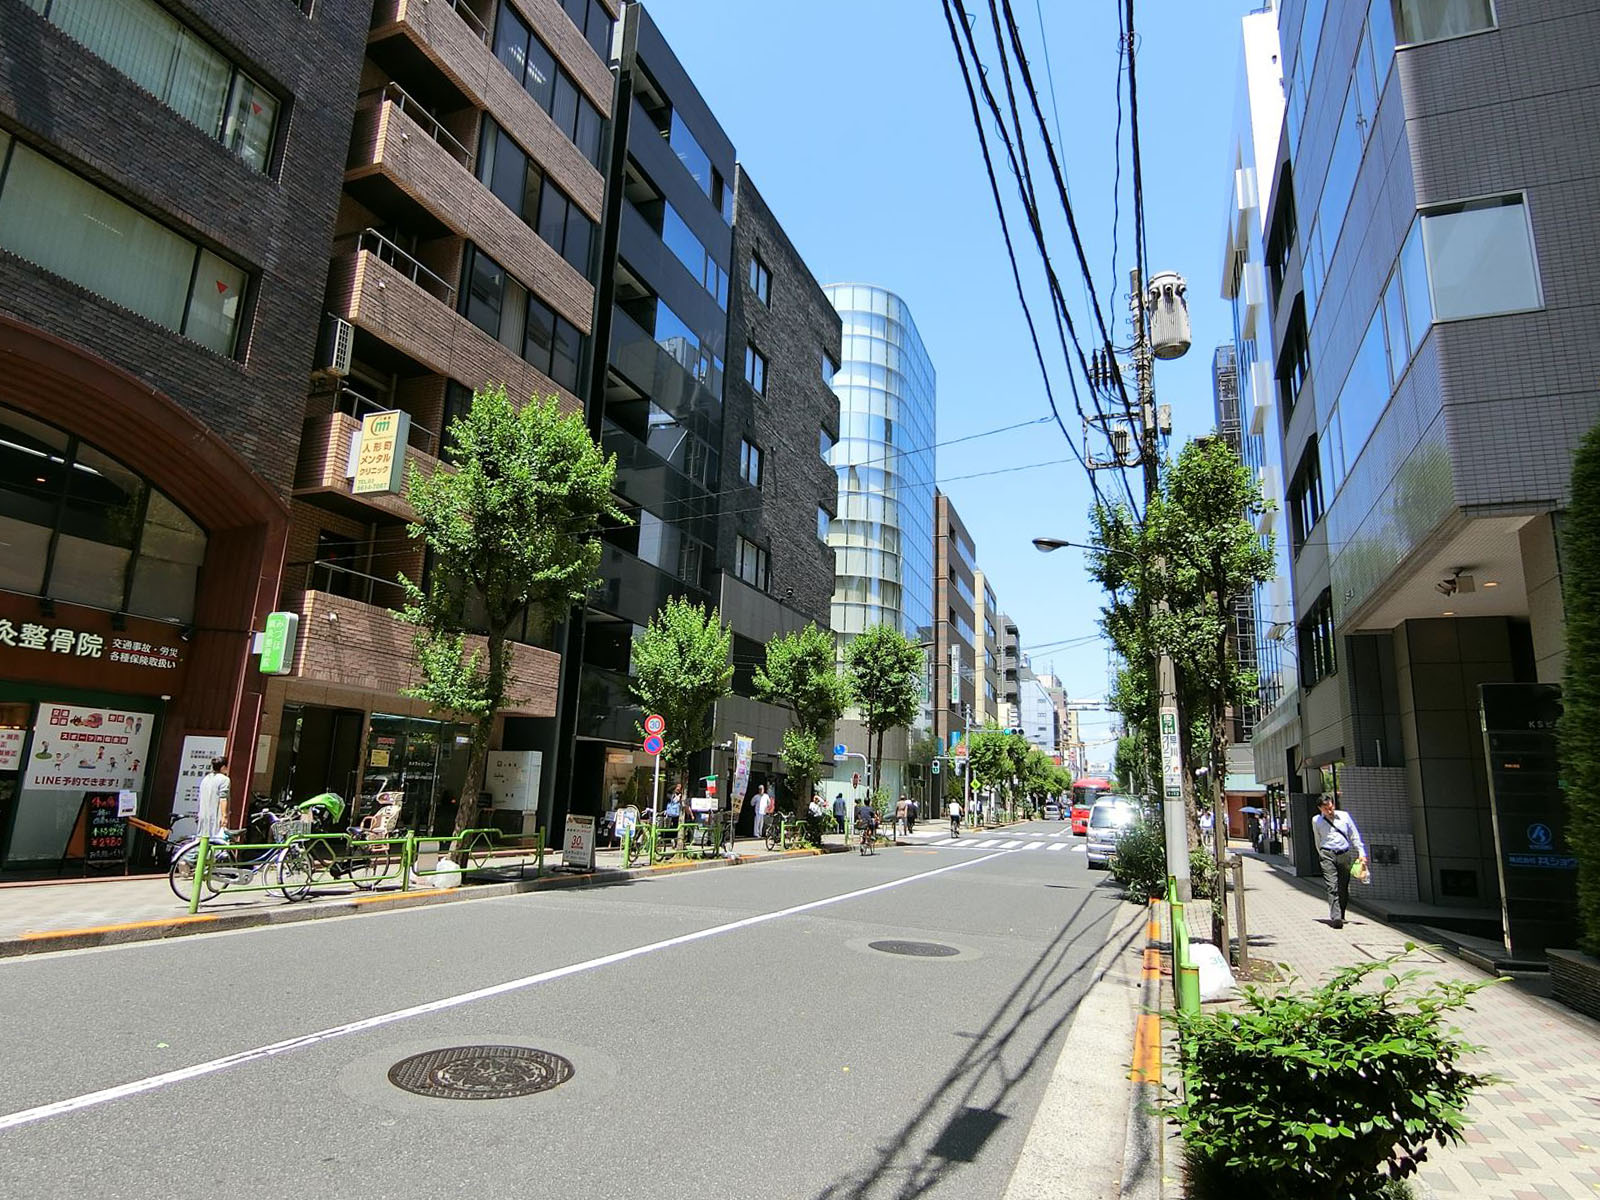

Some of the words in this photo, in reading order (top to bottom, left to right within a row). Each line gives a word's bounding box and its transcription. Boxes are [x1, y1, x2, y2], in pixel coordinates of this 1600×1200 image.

[360, 454, 390, 465] メンタル
[359, 466, 388, 476] クリニック
[112, 638, 179, 658] 交通事故・労災
[110, 651, 177, 669] 各種保険取扱い
[649, 720, 661, 729] 30
[1528, 720, 1553, 728] KSビ
[1162, 736, 1171, 773] クリニック
